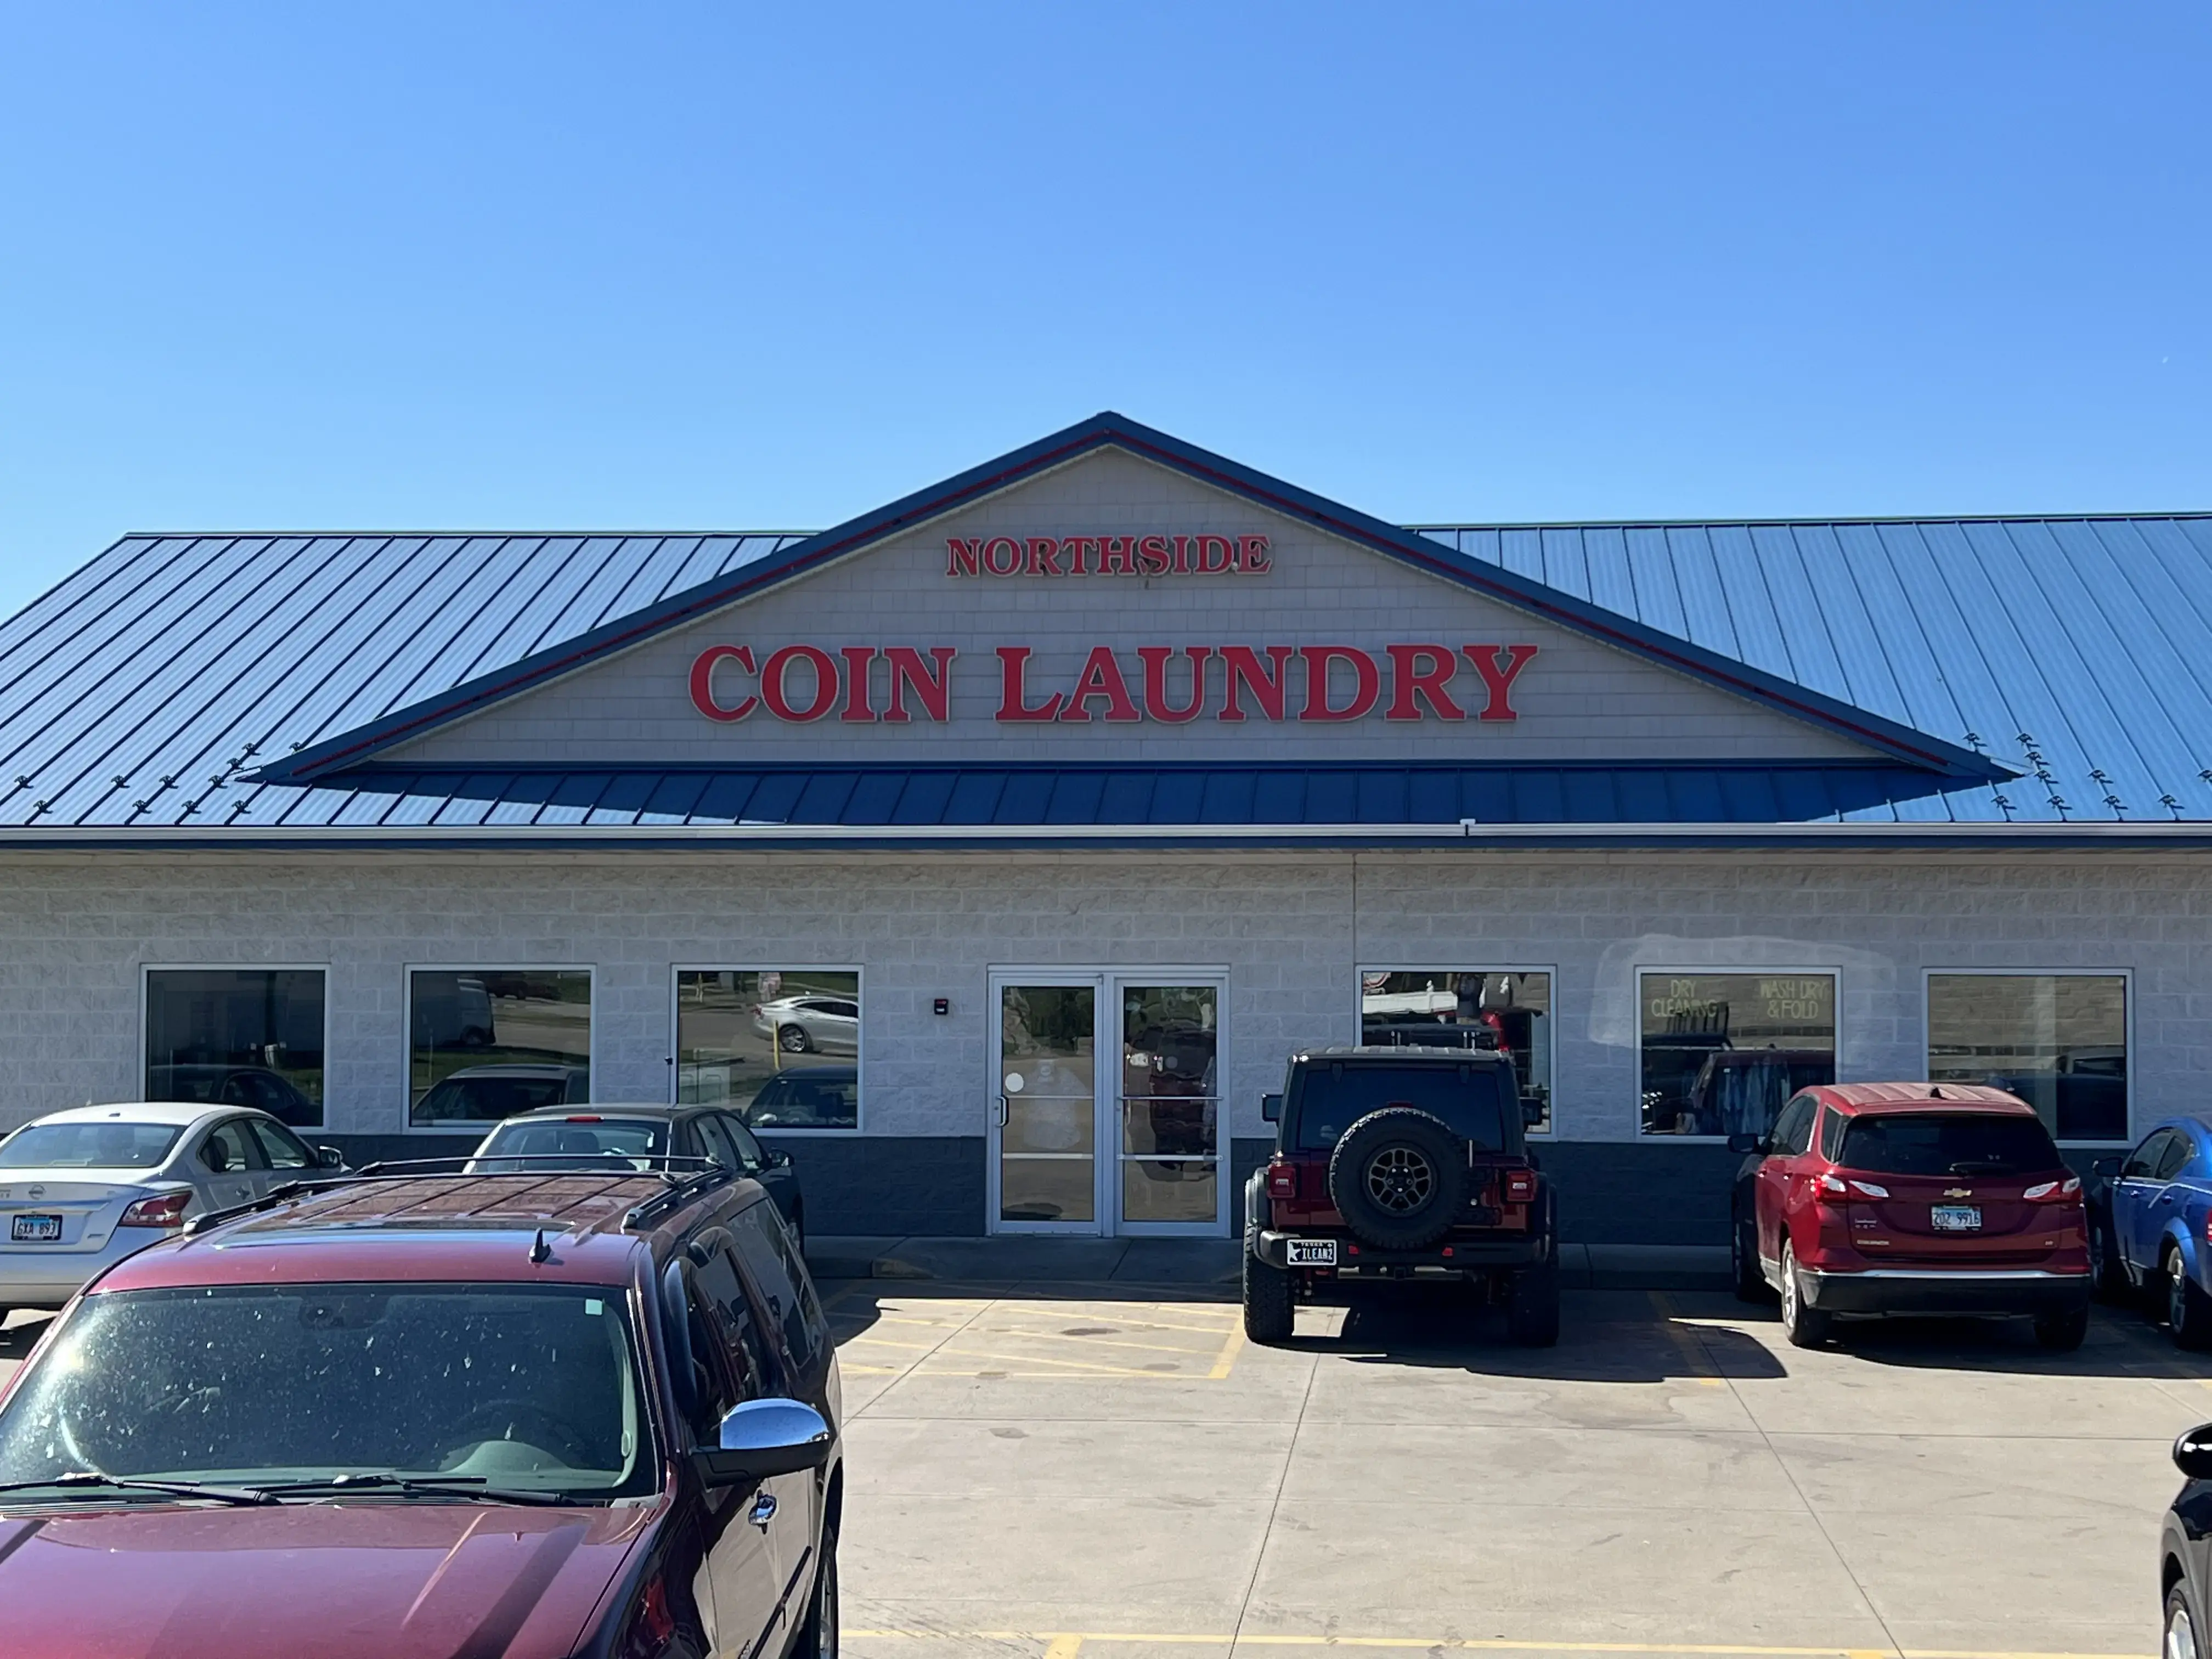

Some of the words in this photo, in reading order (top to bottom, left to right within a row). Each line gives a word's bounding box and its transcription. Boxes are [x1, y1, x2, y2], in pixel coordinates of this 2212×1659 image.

[945, 535, 1272, 577] NORTHSIDE
[688, 644, 957, 724] COIN
[994, 643, 1538, 723] LAUNDRY
[1671, 979, 1696, 998] DRY
[1759, 980, 1795, 998] WASH
[1800, 980, 1830, 1001] DRY
[1782, 1000, 1818, 1019] FOLD
